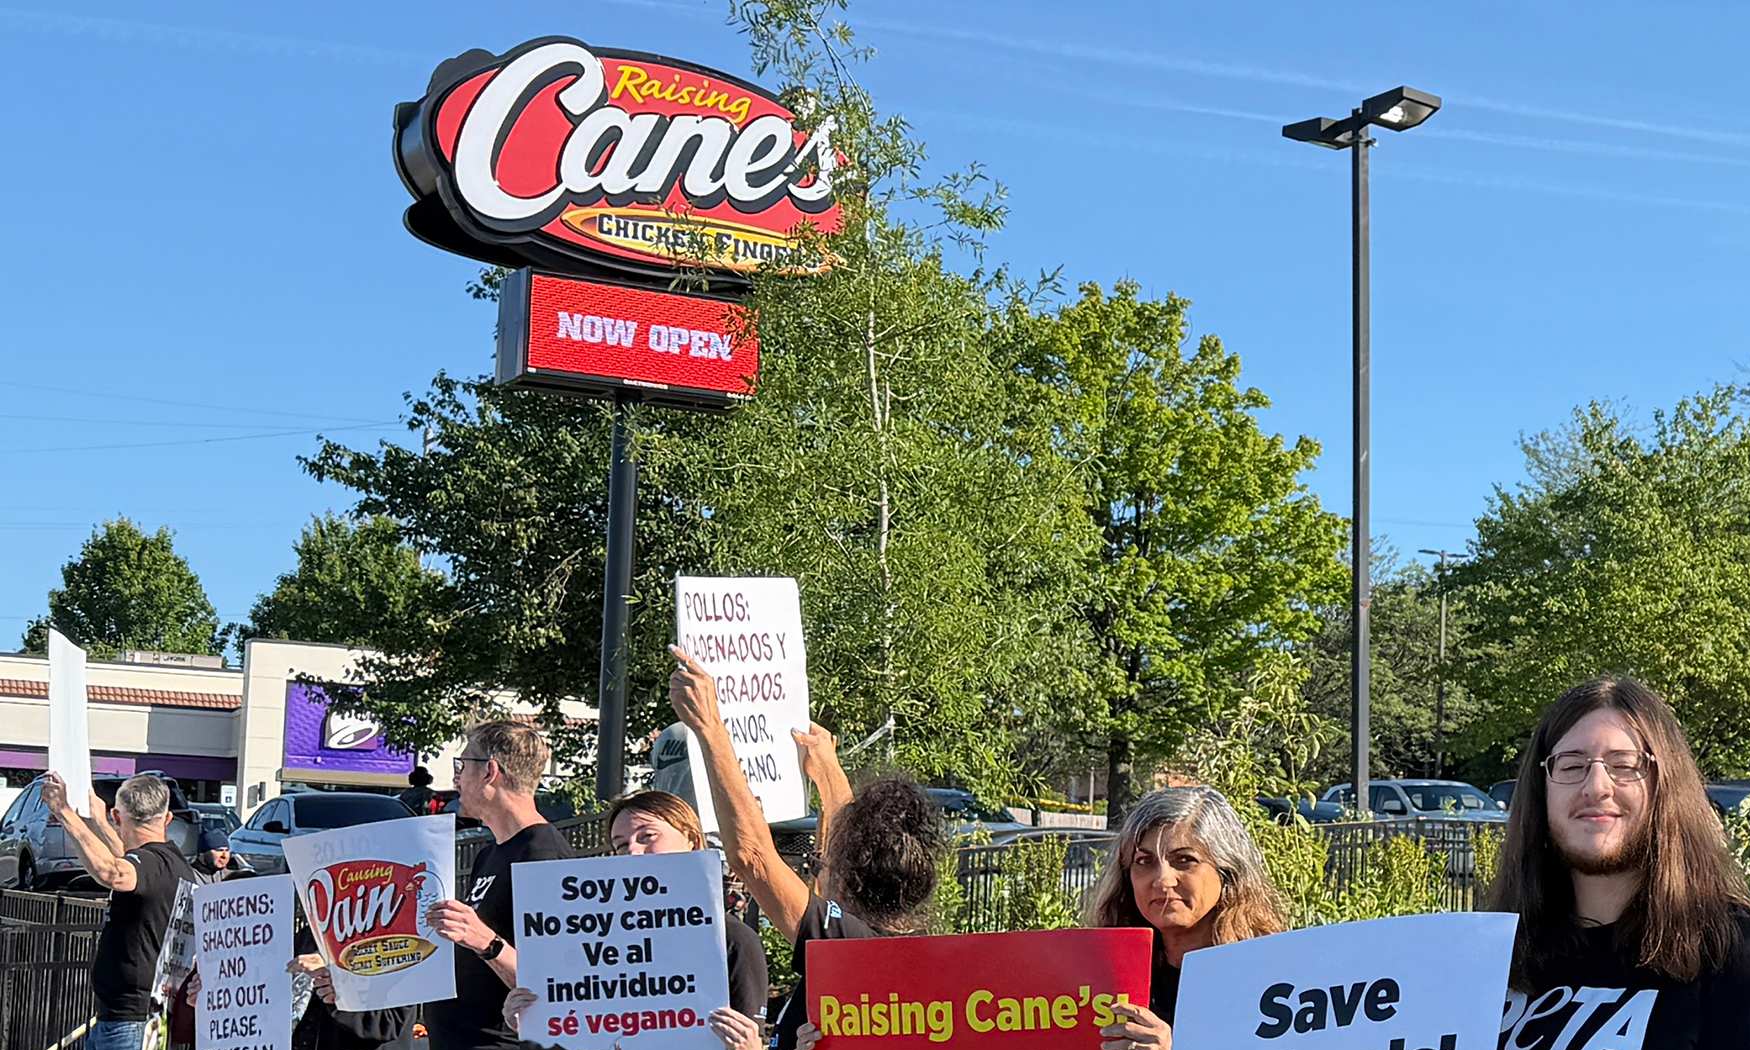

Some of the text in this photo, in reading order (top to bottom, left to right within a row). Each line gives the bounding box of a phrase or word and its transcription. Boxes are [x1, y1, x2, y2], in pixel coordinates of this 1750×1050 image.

[611, 65, 752, 123] Raising
[557, 311, 734, 362] NOW OPEN
[685, 592, 750, 622] POLLOS:
[776, 632, 786, 660] Y
[713, 672, 786, 704] GRADOS.
[338, 864, 394, 891] Causing
[561, 875, 668, 903] Soy yo.
[202, 893, 275, 923] CHICKENS:
[308, 868, 404, 942] Pain
[523, 905, 713, 938] No soy carne.
[203, 923, 273, 952] SHACKLED
[582, 938, 651, 967] Ve al
[218, 956, 246, 979] AND
[235, 984, 269, 1008] OUT.
[546, 971, 696, 1003] individuo:
[547, 1007, 706, 1037] sé vegano.
[820, 992, 953, 1042] Raising
[1255, 977, 1400, 1040] Save
[209, 1015, 262, 1041] PLEASE,
